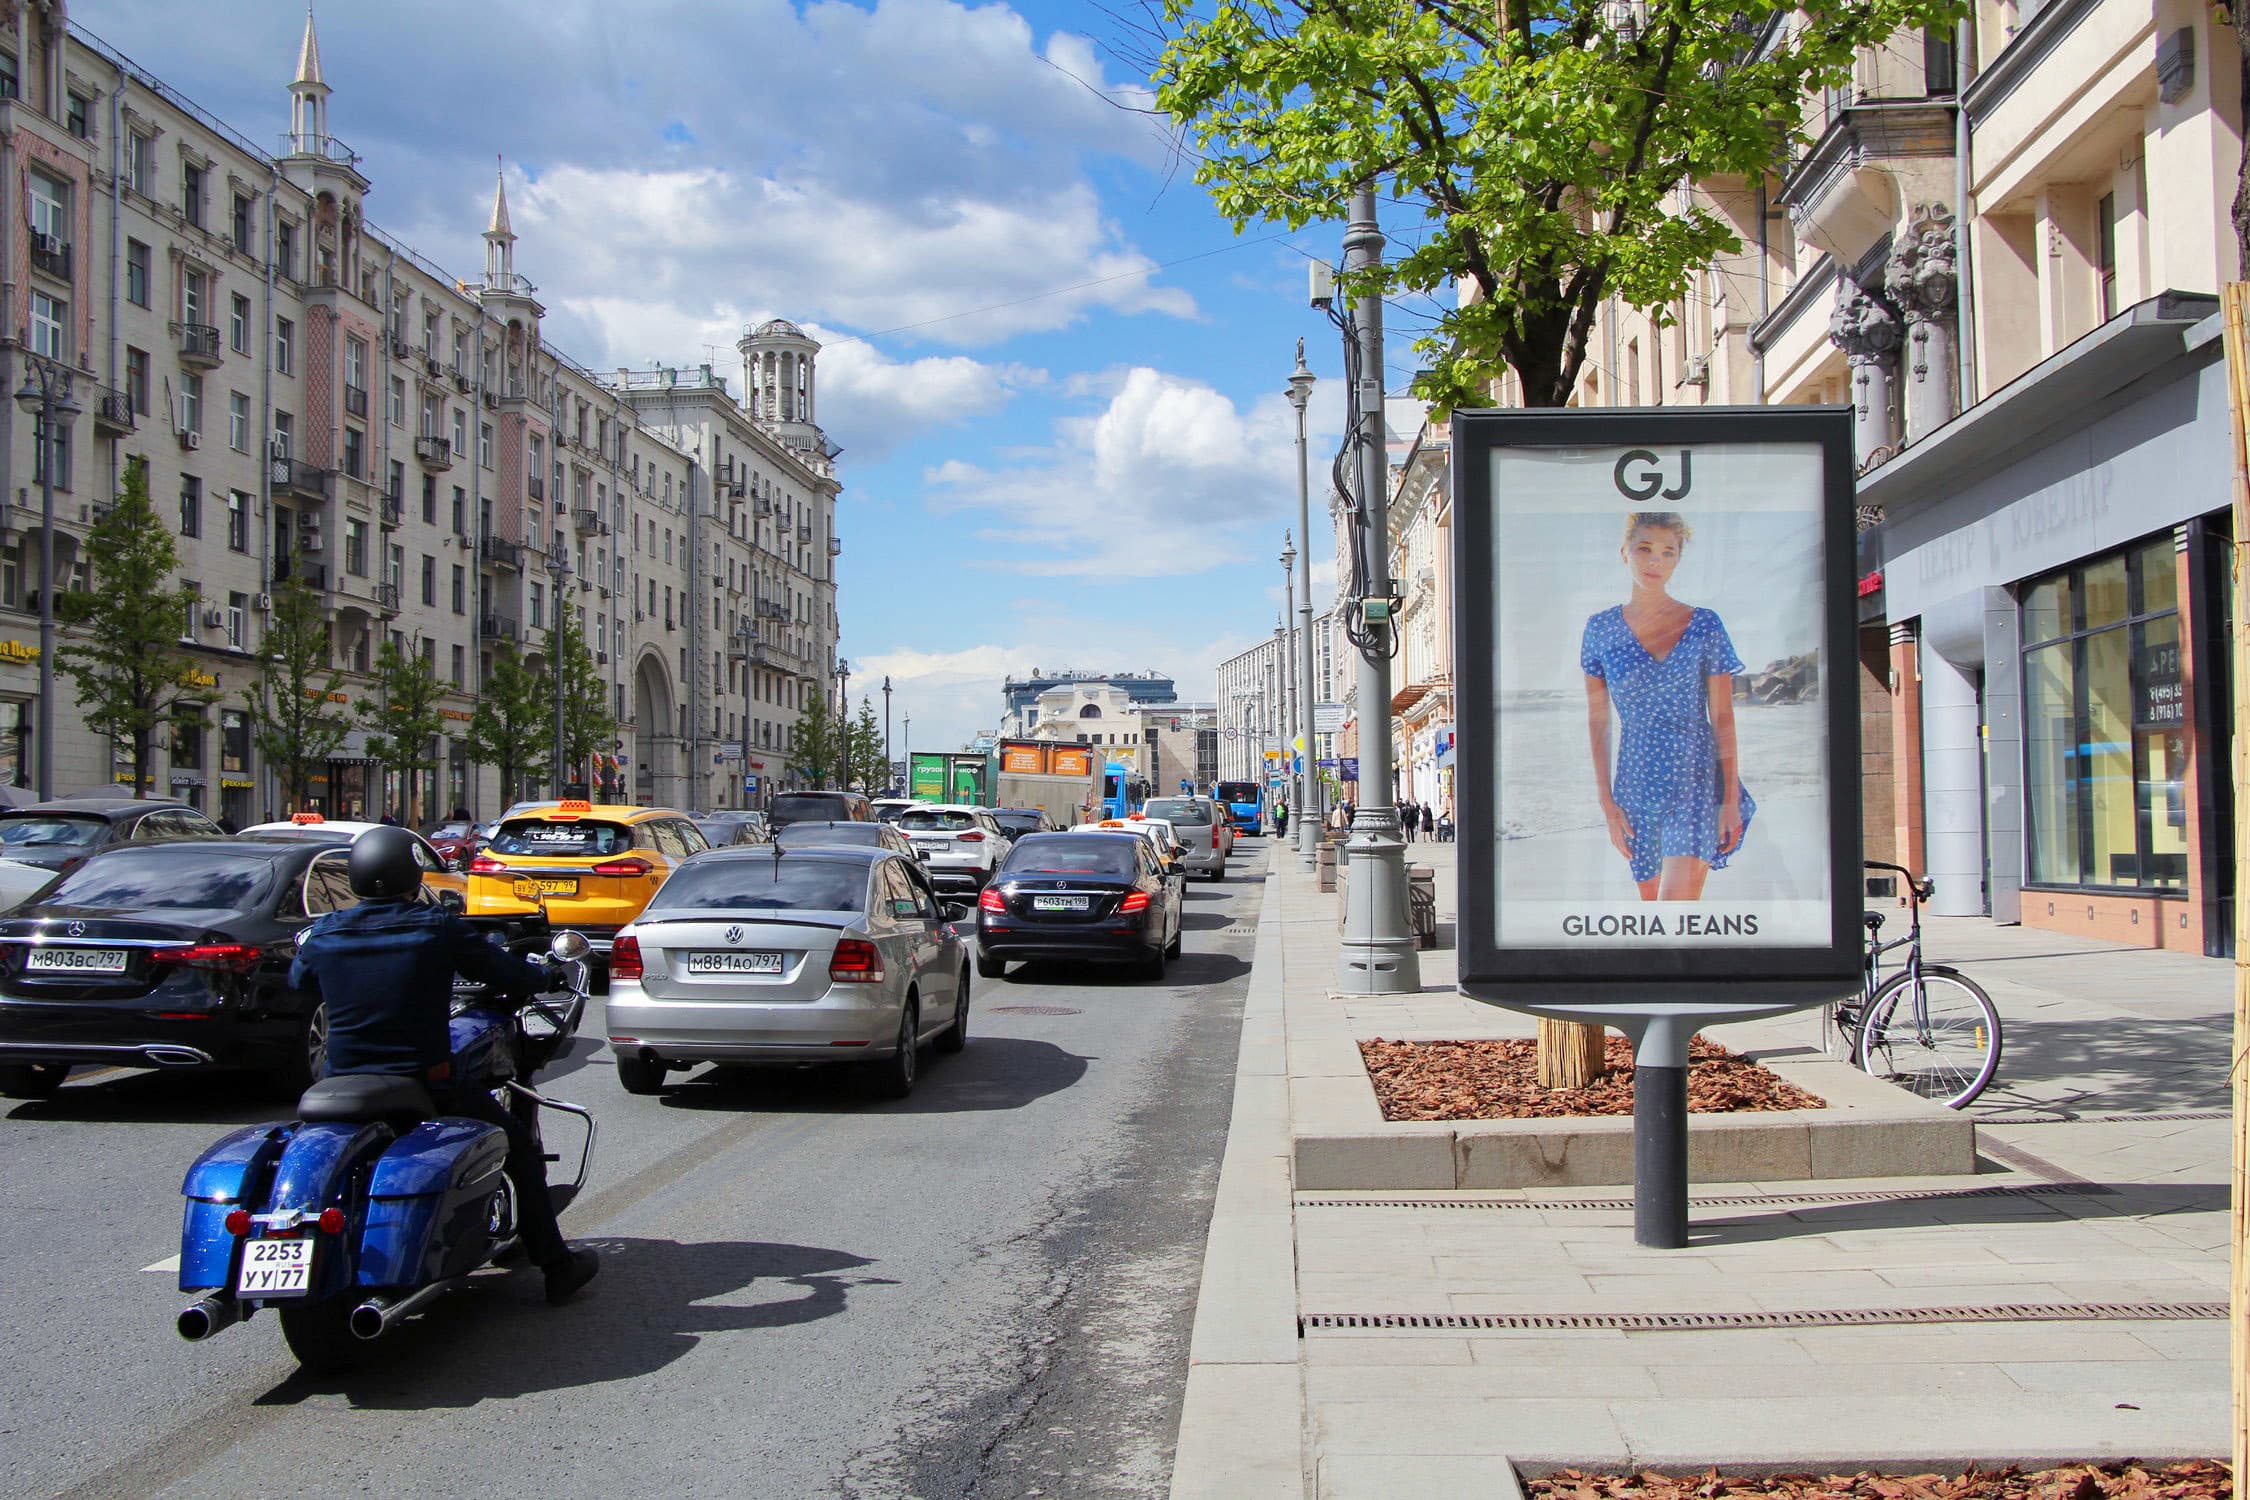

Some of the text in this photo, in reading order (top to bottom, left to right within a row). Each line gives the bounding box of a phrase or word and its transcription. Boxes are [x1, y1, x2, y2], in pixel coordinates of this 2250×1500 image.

[1613, 449, 1692, 501] GJ
[1562, 914, 1759, 937] GLORIA JEANS
[254, 1243, 304, 1261] 2253
[281, 1269, 304, 1287] 77
